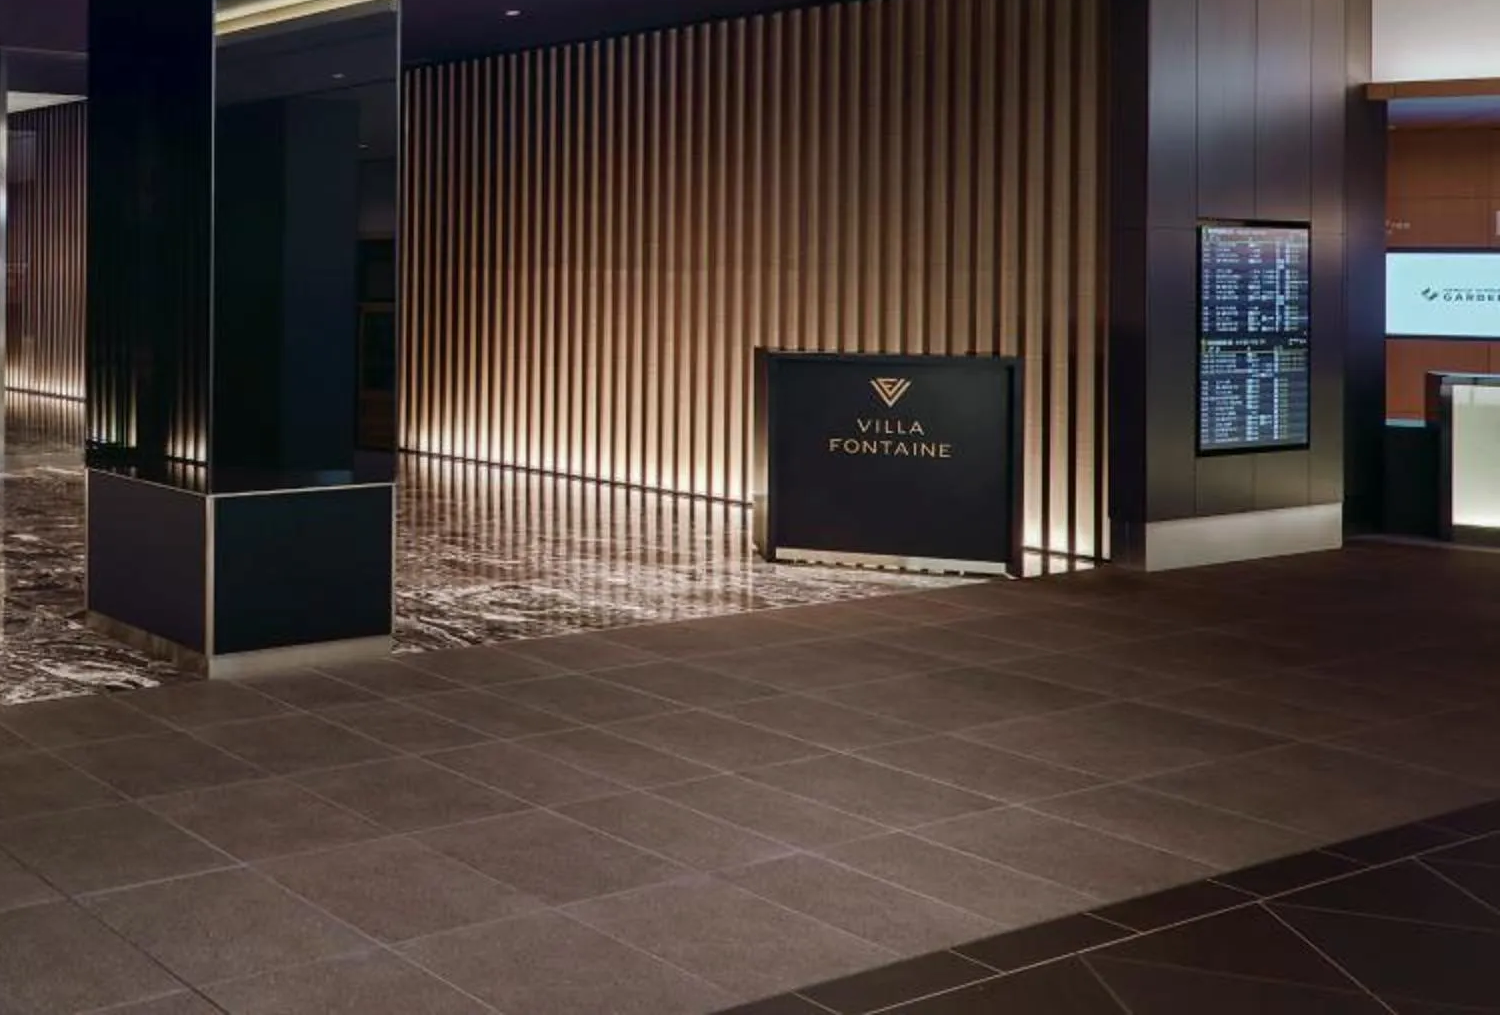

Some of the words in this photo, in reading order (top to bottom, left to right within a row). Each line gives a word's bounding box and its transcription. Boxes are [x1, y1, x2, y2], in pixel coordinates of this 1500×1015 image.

[1443, 292, 1500, 302] GARDE
[856, 418, 925, 435] VILLA
[828, 438, 953, 458] FONTAINE
